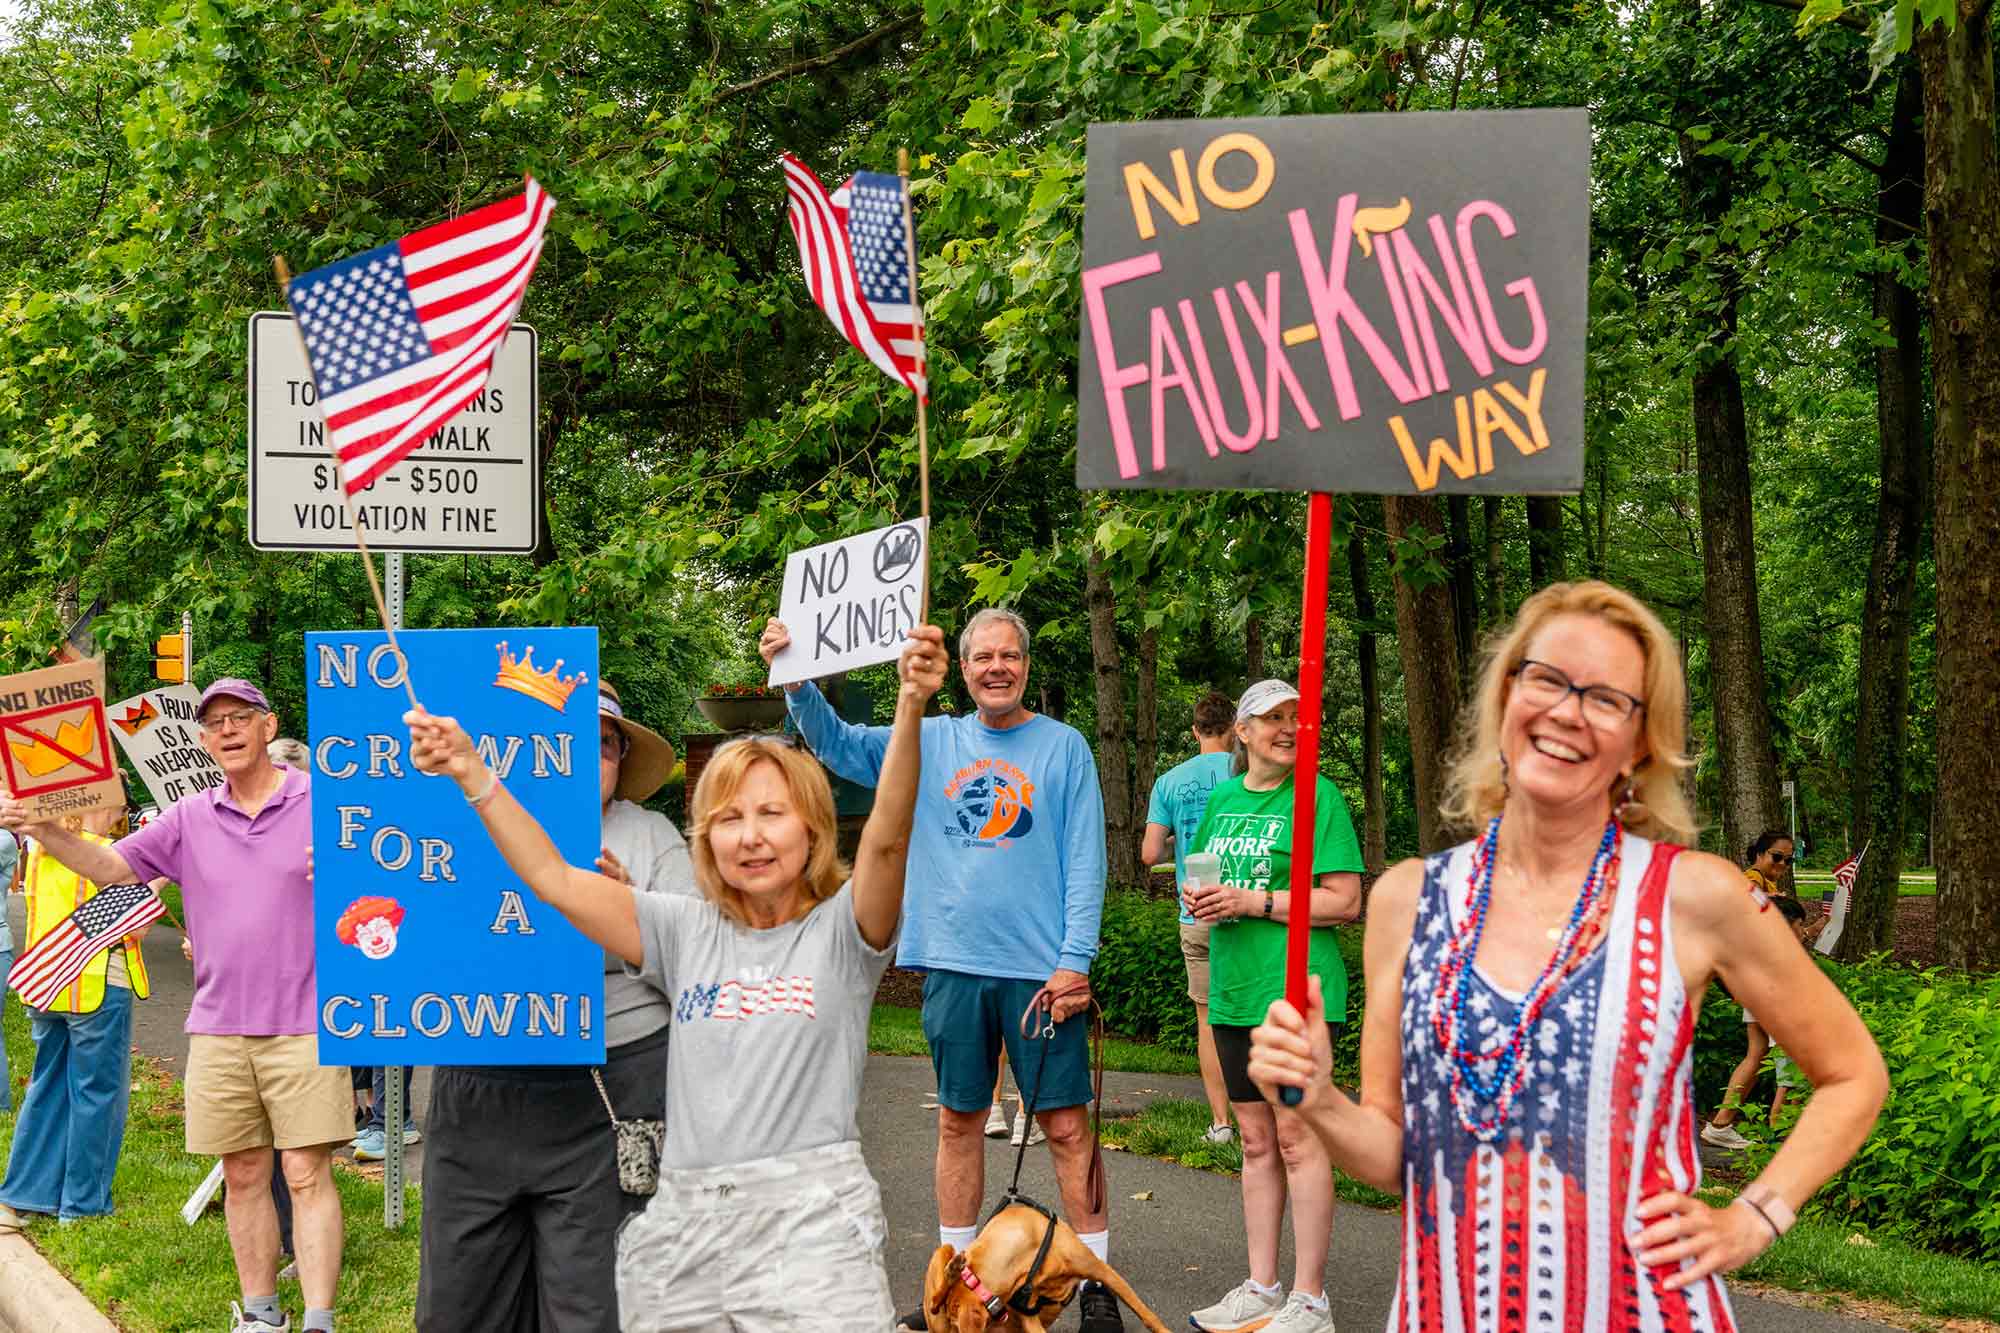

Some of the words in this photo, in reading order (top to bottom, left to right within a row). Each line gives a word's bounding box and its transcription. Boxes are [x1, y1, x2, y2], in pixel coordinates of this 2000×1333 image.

[1123, 132, 1275, 240] NO
[1081, 193, 1548, 480] FAUX-KING
[299, 421, 324, 446] IN
[1387, 368, 1550, 491] WAY
[410, 464, 478, 495] $500
[294, 503, 427, 532] VIOLATION
[442, 506, 497, 532] FINE
[800, 545, 849, 604] NO
[814, 583, 917, 661] KINGS
[316, 643, 410, 688] NO
[0, 691, 28, 713] NO
[34, 679, 95, 706] KINGS
[155, 693, 201, 725] TRUM
[155, 726, 178, 749] IS
[177, 724, 193, 747] A
[144, 746, 217, 778] WEAPON
[38, 786, 88, 804] RESIST
[164, 779, 187, 802] OF
[188, 770, 225, 793] MAS
[336, 805, 457, 883] FOR
[1220, 857, 1246, 878] AY
[489, 891, 536, 935] A
[322, 992, 593, 1040] CLOWN!
